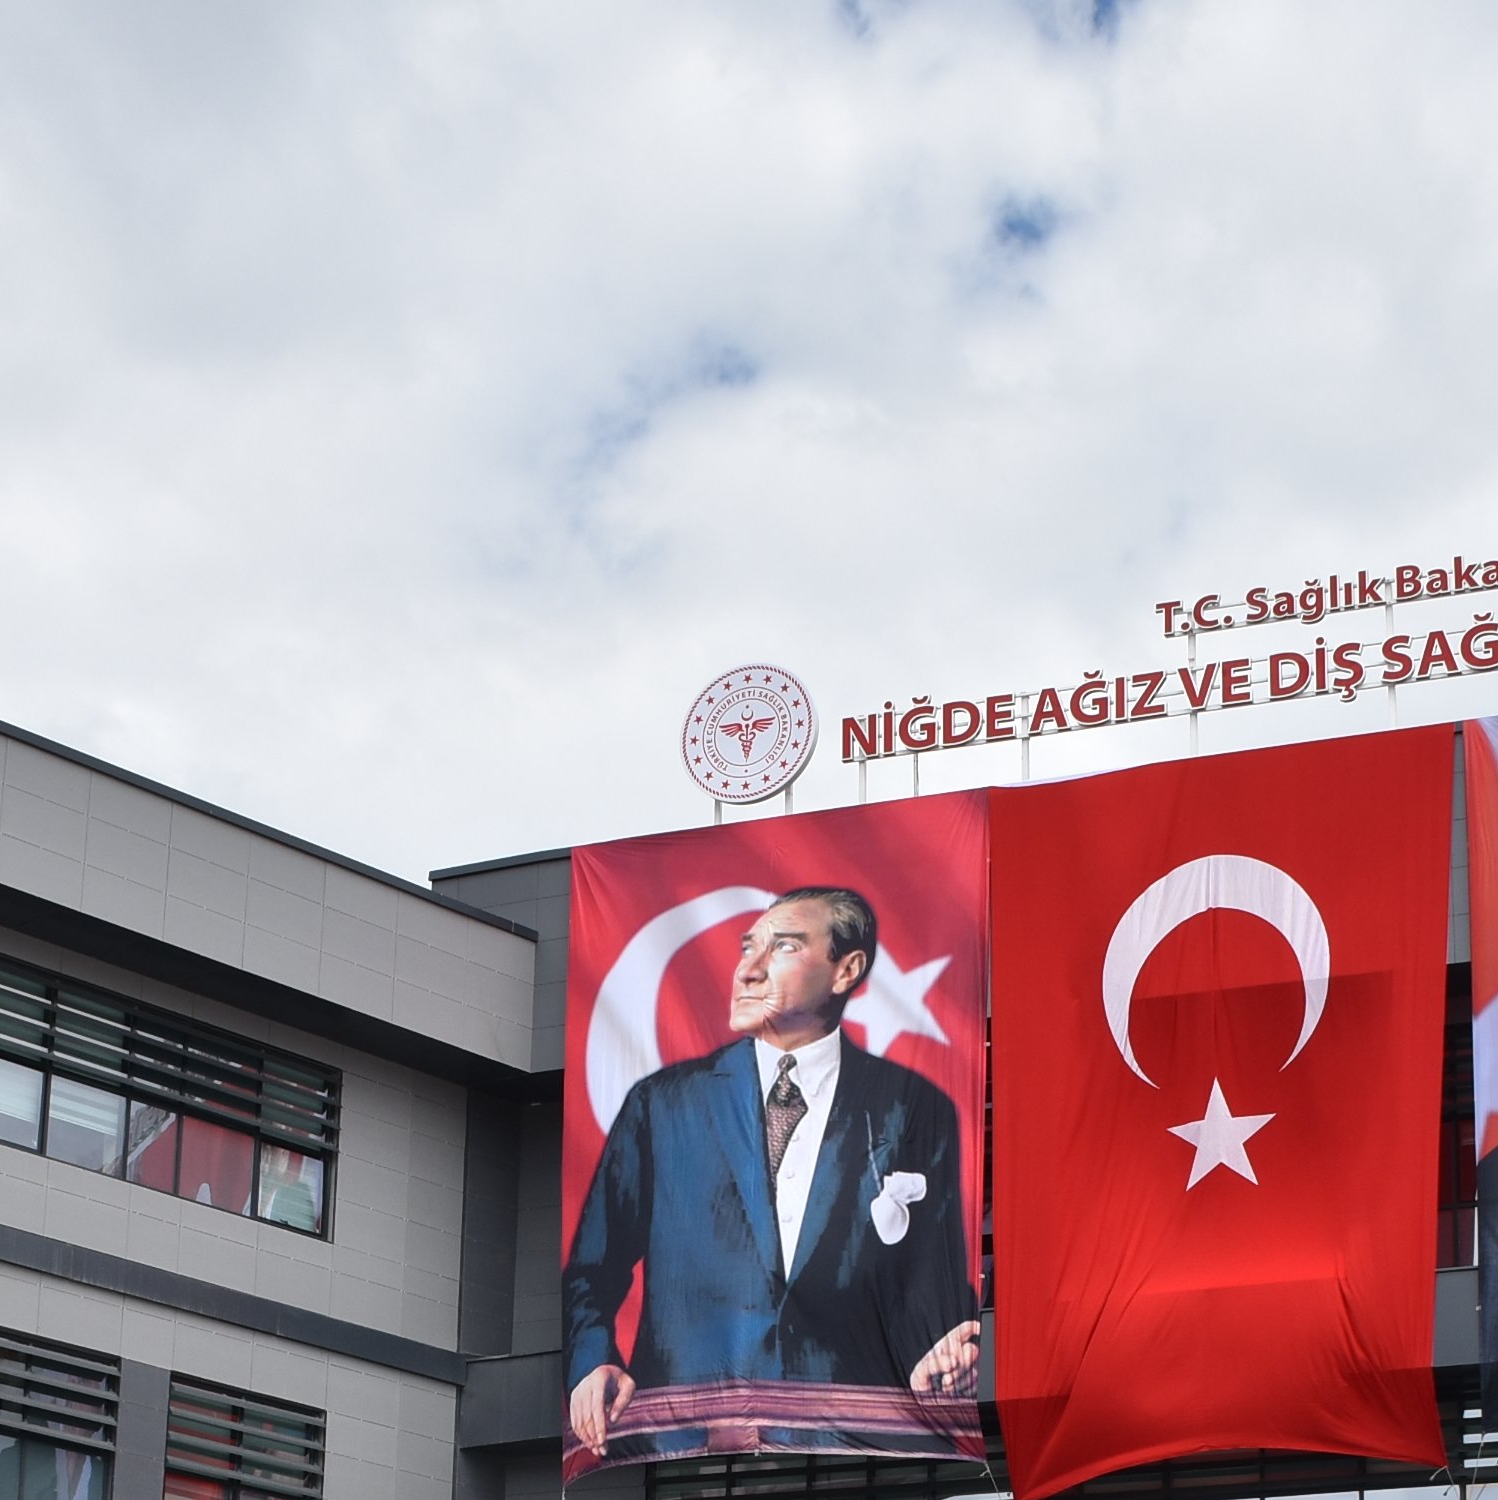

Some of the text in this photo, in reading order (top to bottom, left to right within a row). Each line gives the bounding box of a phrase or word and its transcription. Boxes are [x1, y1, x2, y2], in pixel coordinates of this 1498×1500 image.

[1156, 594, 1233, 636] T.C.
[1246, 570, 1382, 623] Sağlık
[705, 689, 789, 772] TÜRKİYE CUMHURİYETİ SAĞLIK BAKANLIĞI
[842, 695, 1015, 761] NİĞDE
[1030, 670, 1165, 734] AĞIZ
[1178, 658, 1251, 709] VE
[1269, 636, 1365, 700] DİŞ
